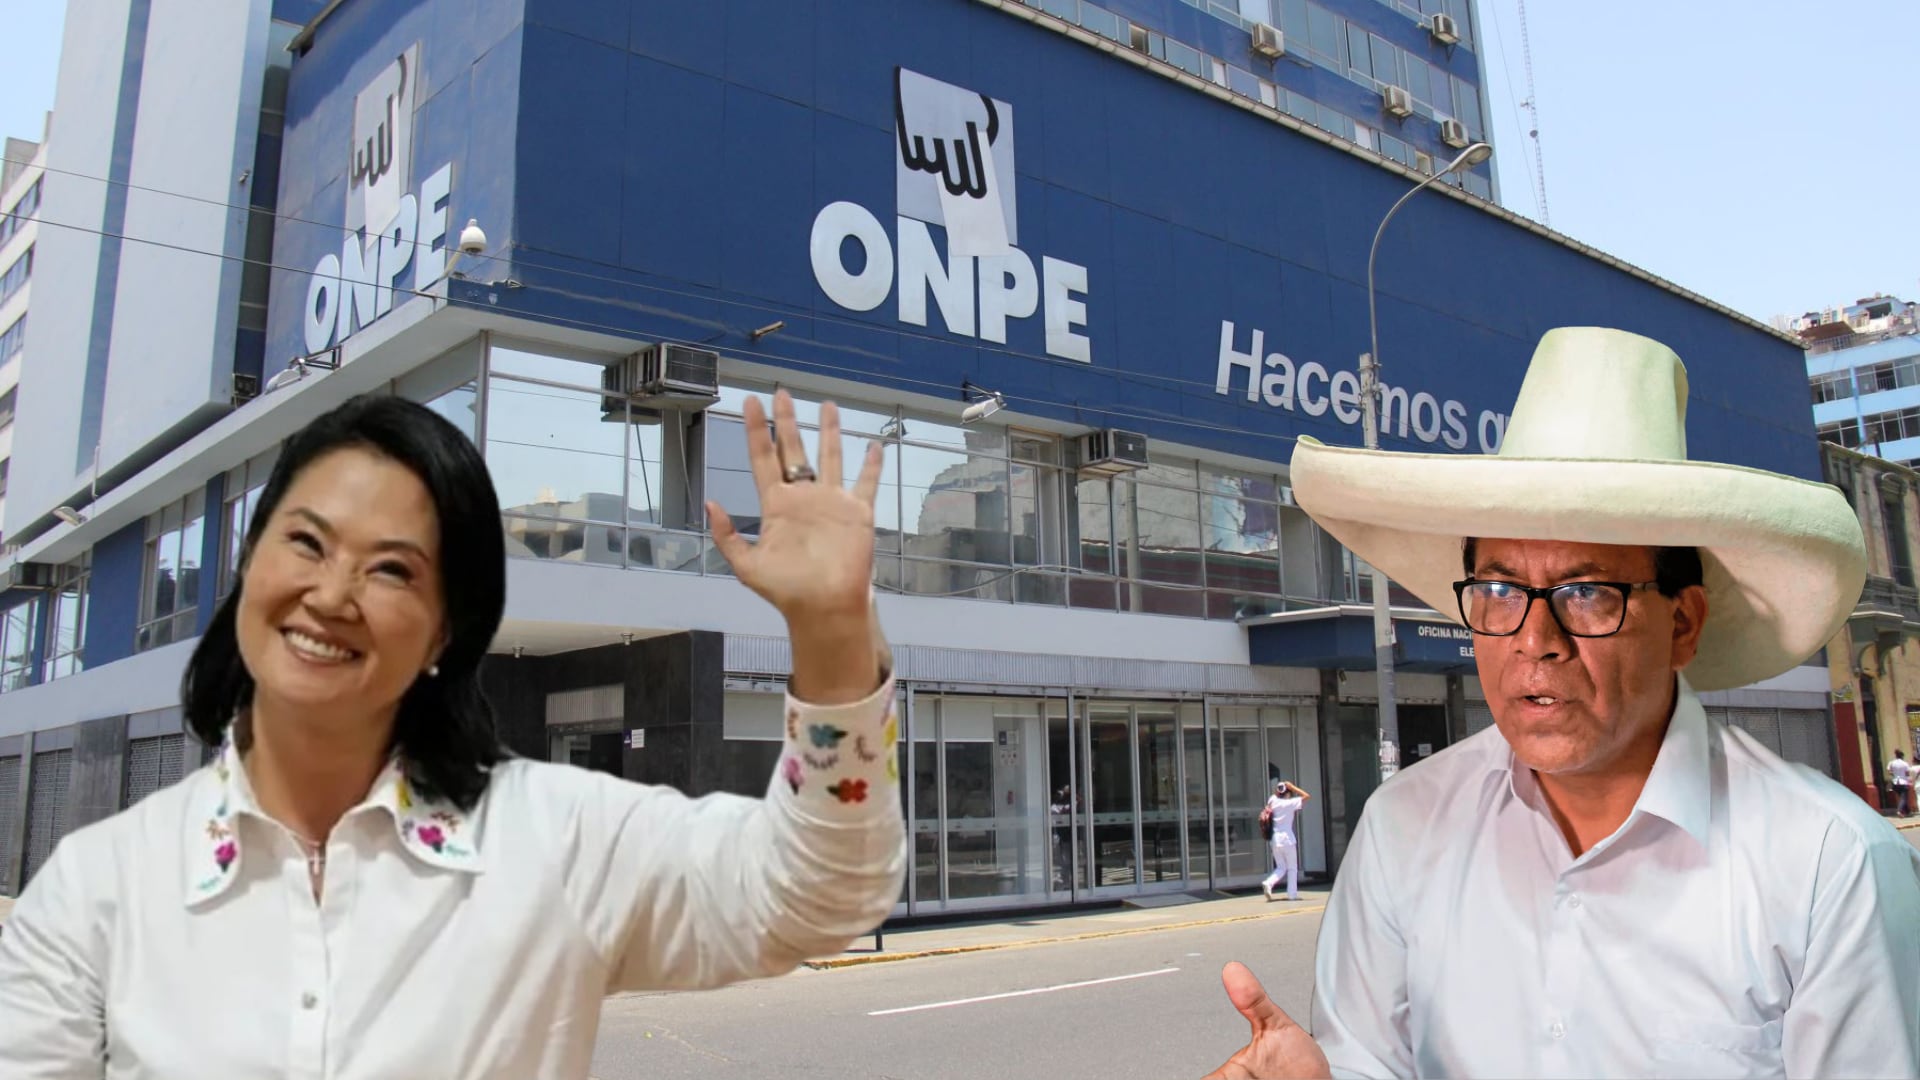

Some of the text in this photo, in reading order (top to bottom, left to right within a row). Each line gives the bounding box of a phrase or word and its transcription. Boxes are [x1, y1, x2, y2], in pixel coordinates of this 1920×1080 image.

[304, 162, 452, 354] ONPE
[810, 201, 1092, 363] ONPE
[1215, 319, 1468, 450] Hacemos
[1418, 625, 1452, 639] OFICINA
[1459, 646, 1475, 657] ELE
